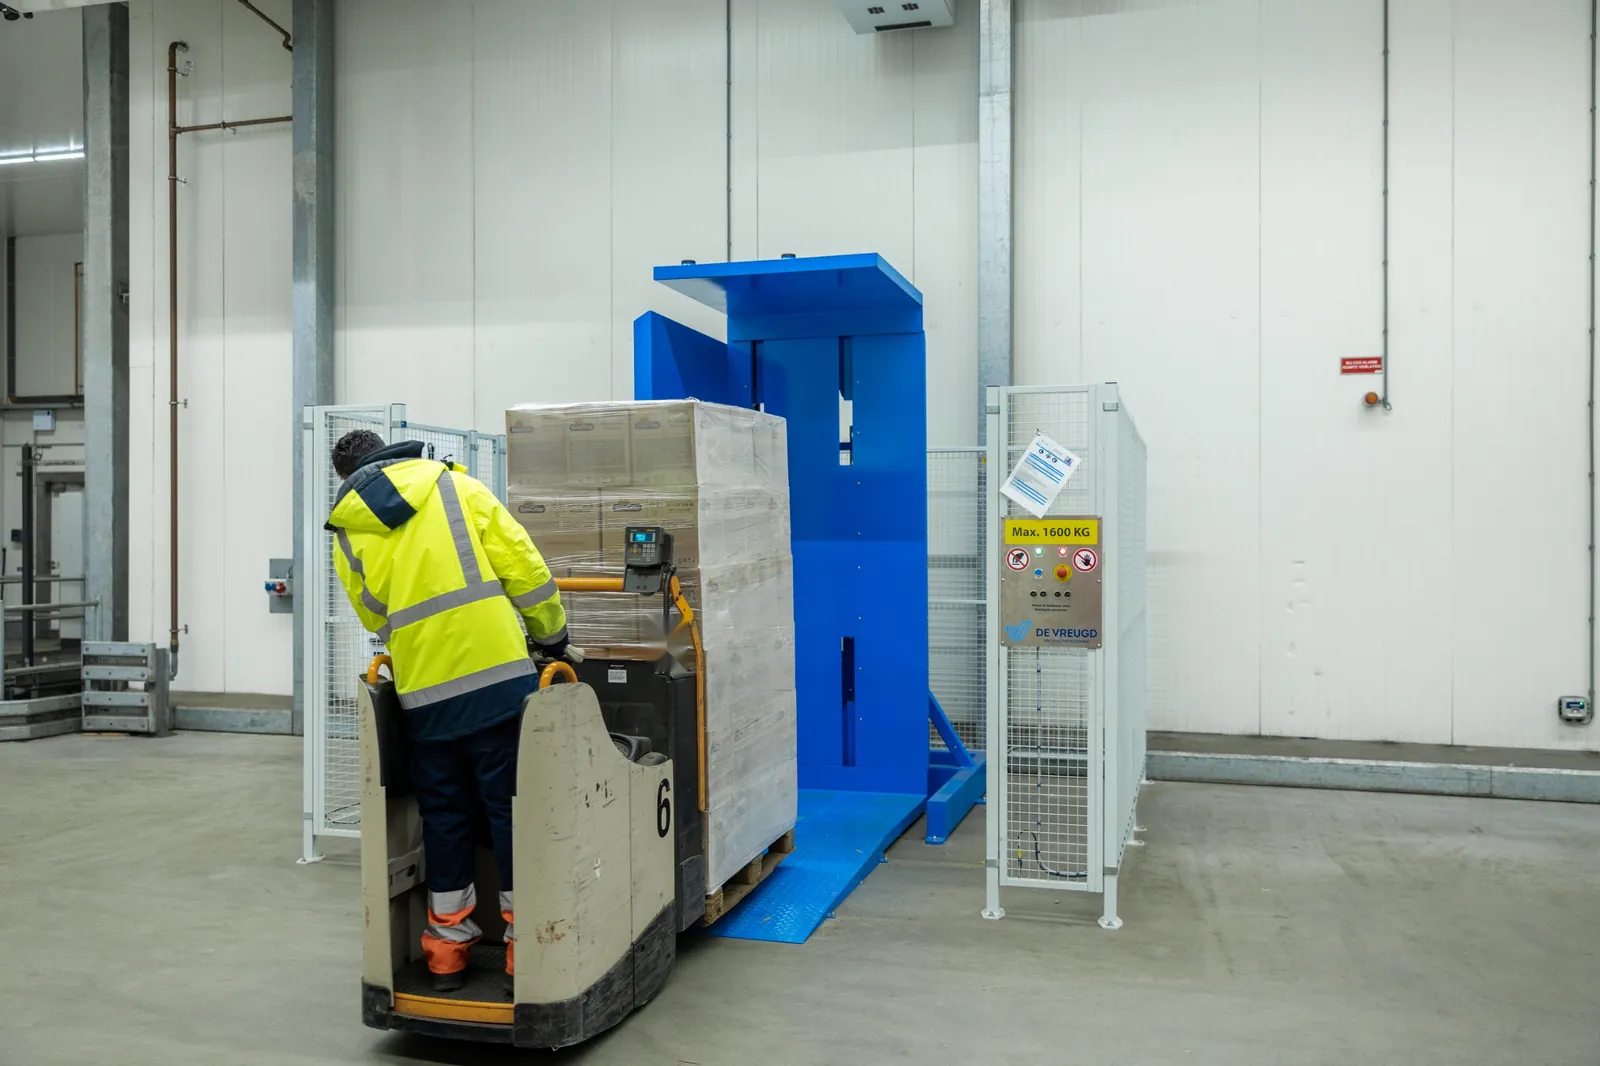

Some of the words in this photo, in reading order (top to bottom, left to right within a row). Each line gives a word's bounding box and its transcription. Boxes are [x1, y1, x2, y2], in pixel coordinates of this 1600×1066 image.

[1012, 527, 1039, 536] Max.
[1043, 527, 1071, 536] 1600
[1074, 527, 1090, 536] KG
[1036, 629, 1050, 637] DE
[1052, 629, 1098, 638] VREUGD
[657, 778, 671, 838] 6
